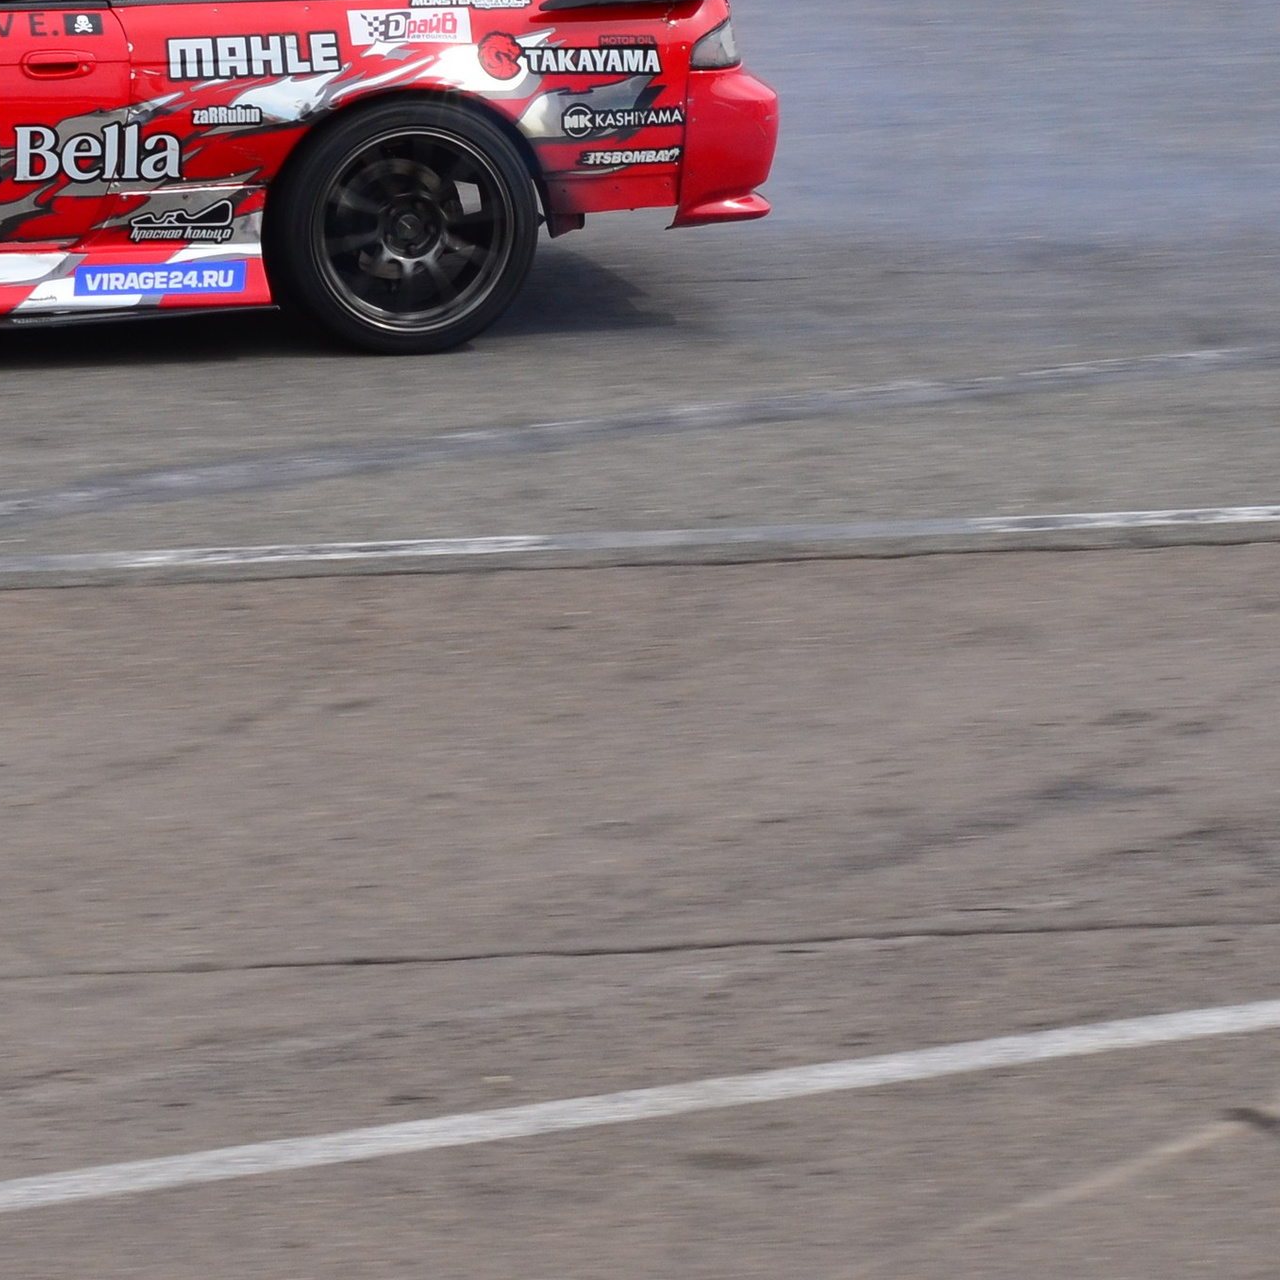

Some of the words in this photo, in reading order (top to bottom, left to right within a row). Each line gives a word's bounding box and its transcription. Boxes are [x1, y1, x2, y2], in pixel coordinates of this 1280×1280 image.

[28, 12, 60, 37] E.
[600, 36, 637, 45] MOTOR
[637, 35, 656, 45] OIL
[167, 32, 341, 78] MAHLE
[525, 48, 661, 74] TAKAYAMA
[192, 106, 261, 125] zaRRubin
[594, 108, 684, 128] KASHIYAMA
[14, 123, 182, 182] Bella
[85, 269, 235, 292] VIRAGE24.RU
